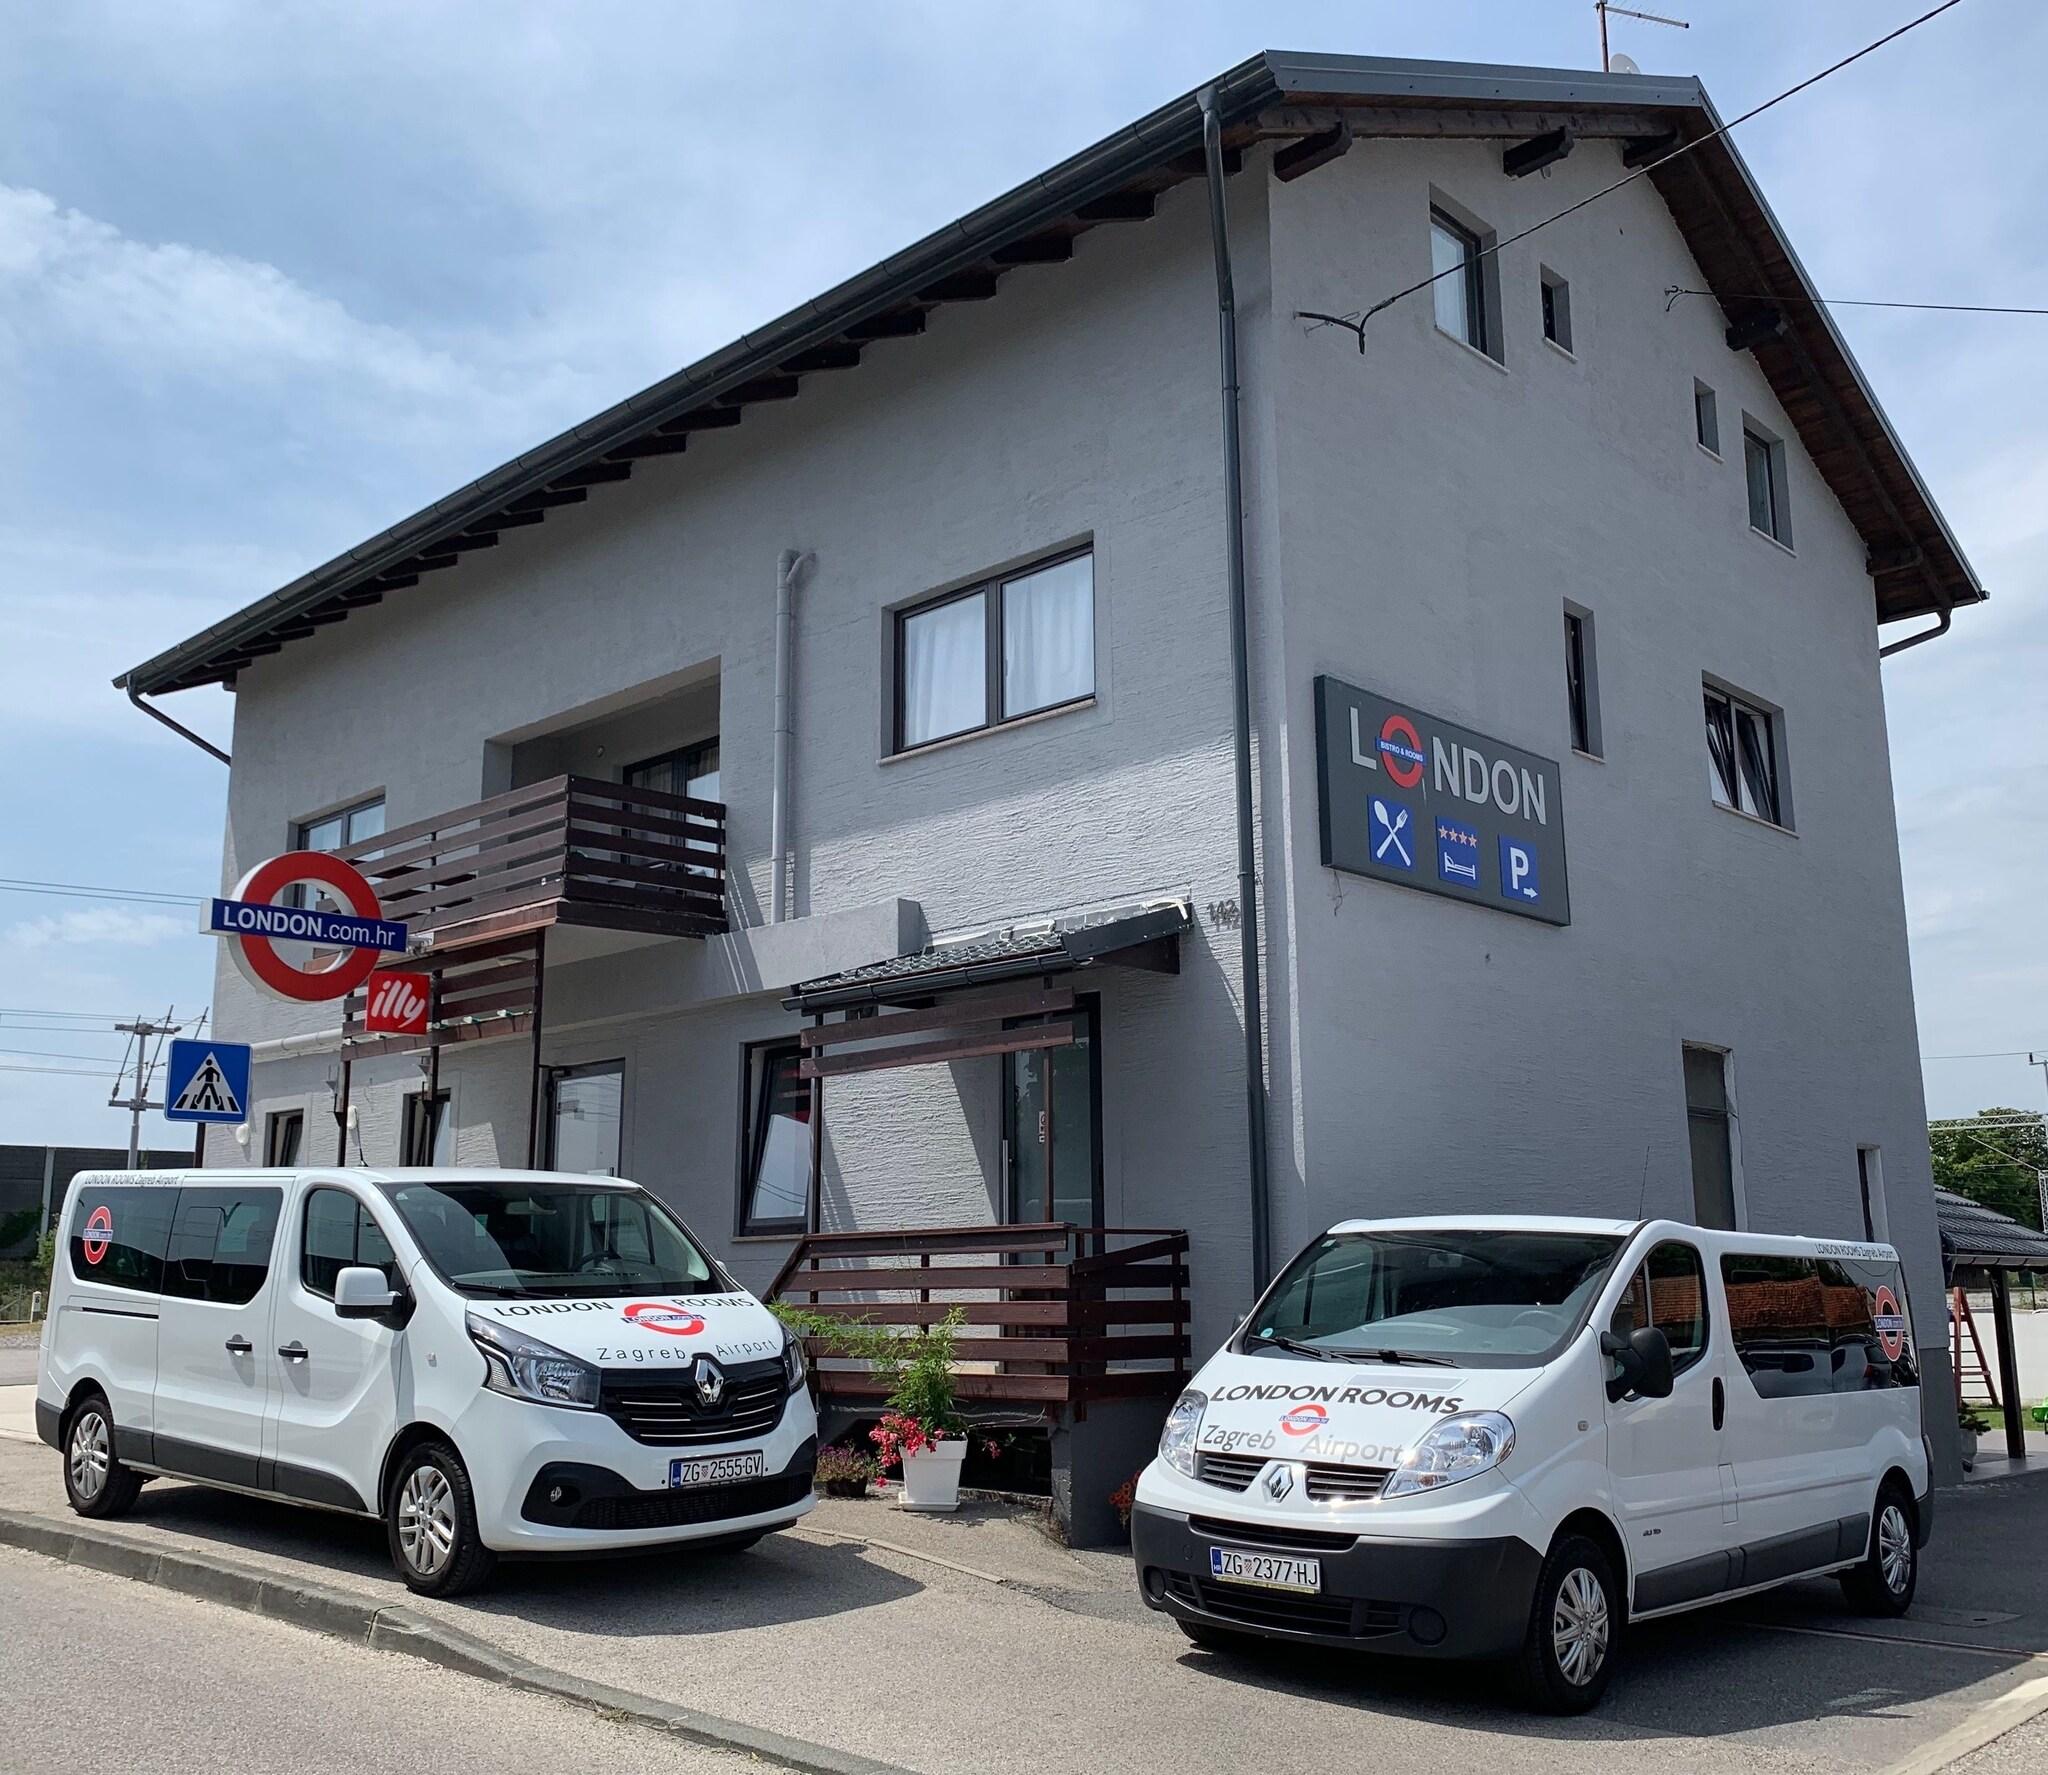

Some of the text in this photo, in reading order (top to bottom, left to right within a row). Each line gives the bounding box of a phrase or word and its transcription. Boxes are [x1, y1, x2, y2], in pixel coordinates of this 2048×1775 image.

[1380, 740, 1400, 754] BISTRO
[1405, 749, 1424, 762] ROOMS
[1509, 846, 1530, 890] P
[222, 905, 397, 946] LONDON.com.hr
[370, 979, 426, 1029] illy
[85, 1173, 111, 1185] LONDON
[494, 1298, 754, 1317] LONDON ROOMS
[597, 1339, 778, 1363] Zagreb Airport
[1209, 1384, 1465, 1415] LONDON ROOMS
[1202, 1423, 1405, 1464] Zagreb Airport
[682, 1463, 701, 1483] ZG
[1222, 1552, 1243, 1575] ZG
